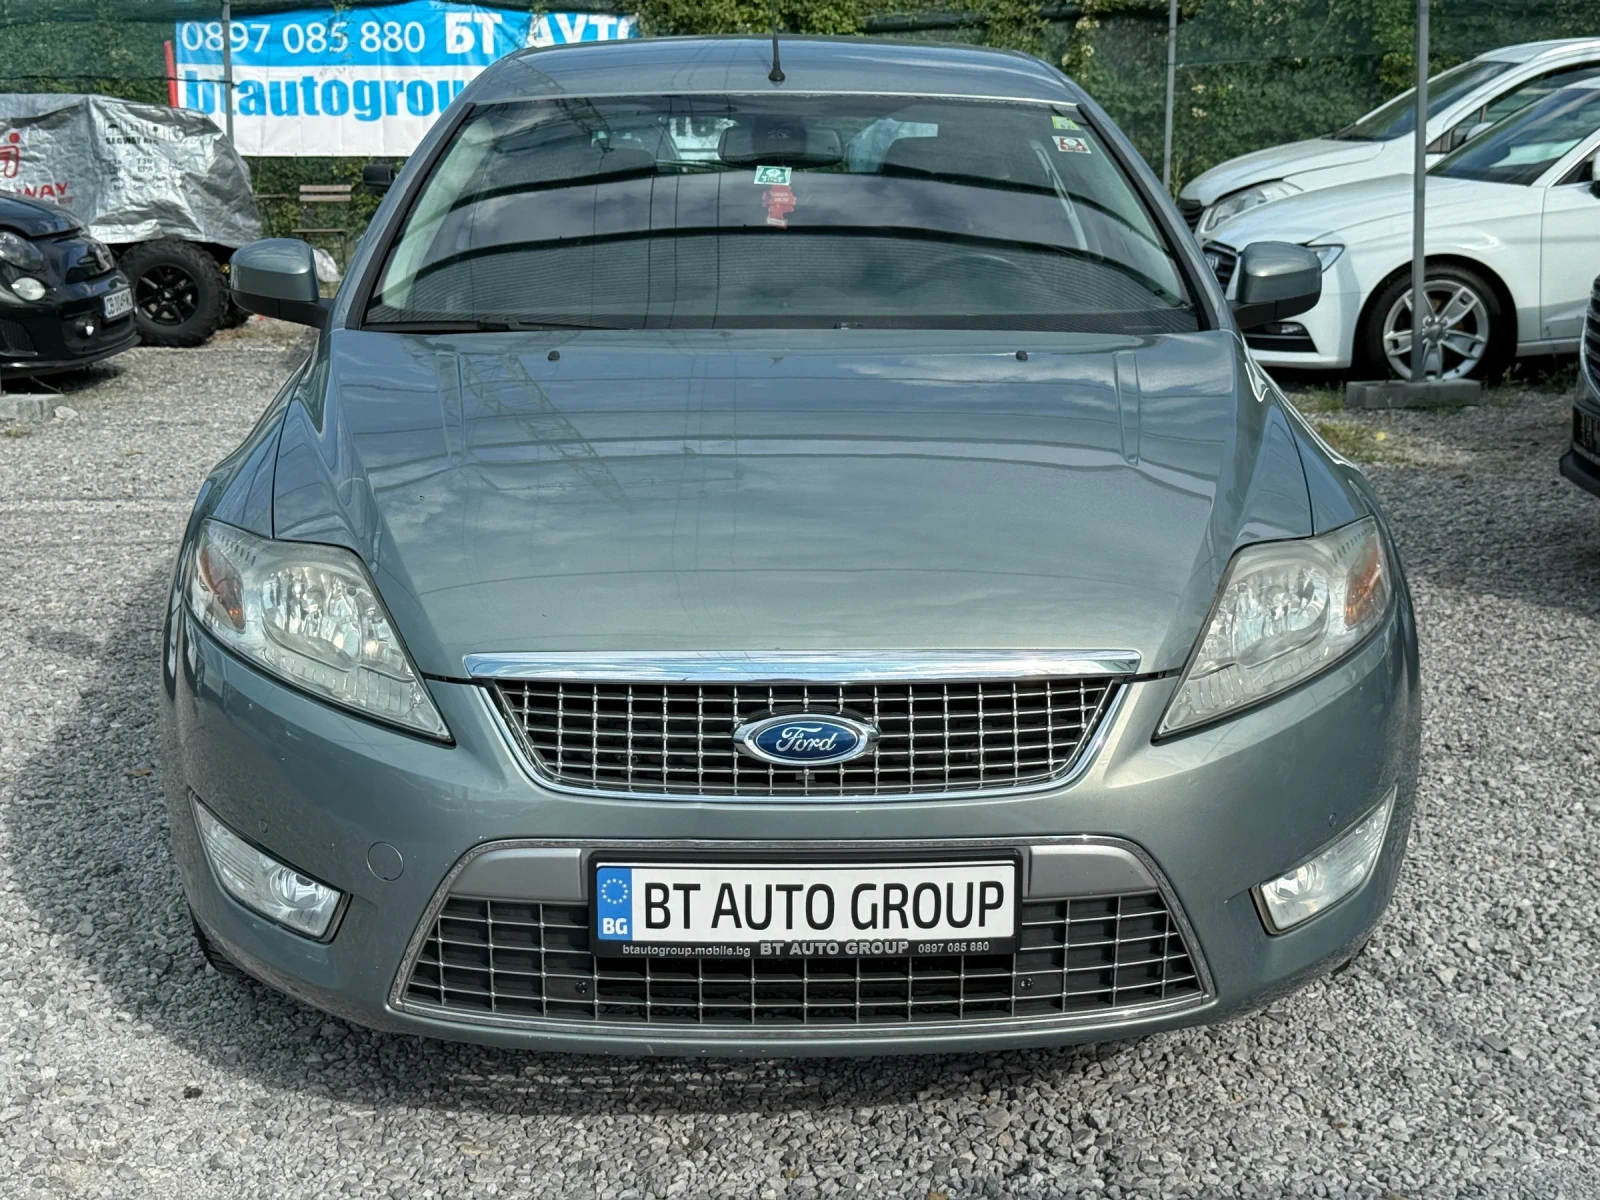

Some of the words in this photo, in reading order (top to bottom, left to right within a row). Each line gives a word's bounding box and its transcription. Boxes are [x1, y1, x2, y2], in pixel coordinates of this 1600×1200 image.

[181, 21, 271, 53] 0897
[282, 22, 349, 54] 085
[360, 20, 425, 53] 880
[445, 12, 502, 54] БТ
[776, 726, 838, 752] Ford
[645, 884, 701, 930] BT
[711, 882, 835, 930] AUTO
[851, 880, 1005, 929] GROUP
[602, 917, 629, 936] BG
[622, 944, 751, 957] btautogroup.mobile.bg
[760, 942, 784, 956] BT
[789, 942, 840, 956] AUTO
[845, 941, 909, 955] GROUP
[918, 943, 943, 954] 0897
[947, 942, 967, 953] 085
[970, 941, 990, 952] 880
